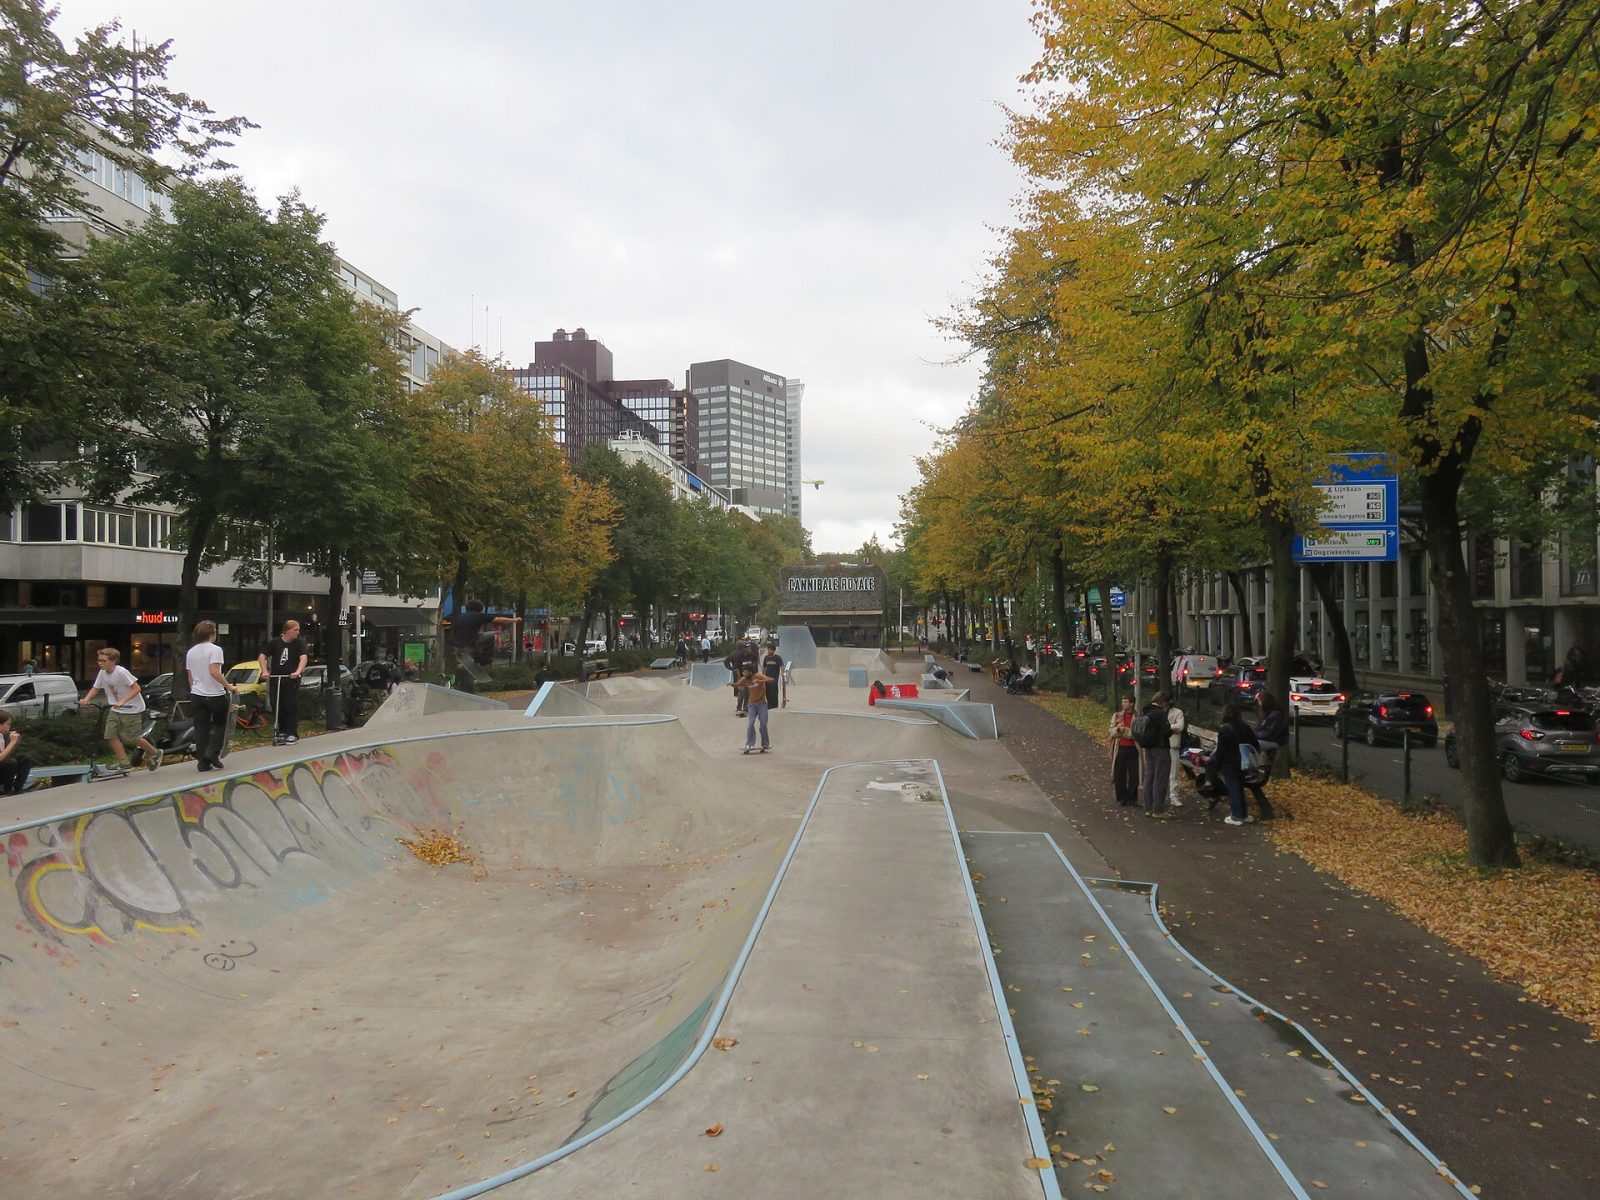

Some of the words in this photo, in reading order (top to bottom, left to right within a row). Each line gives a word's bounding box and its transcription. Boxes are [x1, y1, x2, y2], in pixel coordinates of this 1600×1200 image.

[789, 577, 838, 591] CANNIBALE
[841, 577, 875, 591] ROYALE
[142, 611, 162, 623] huid
